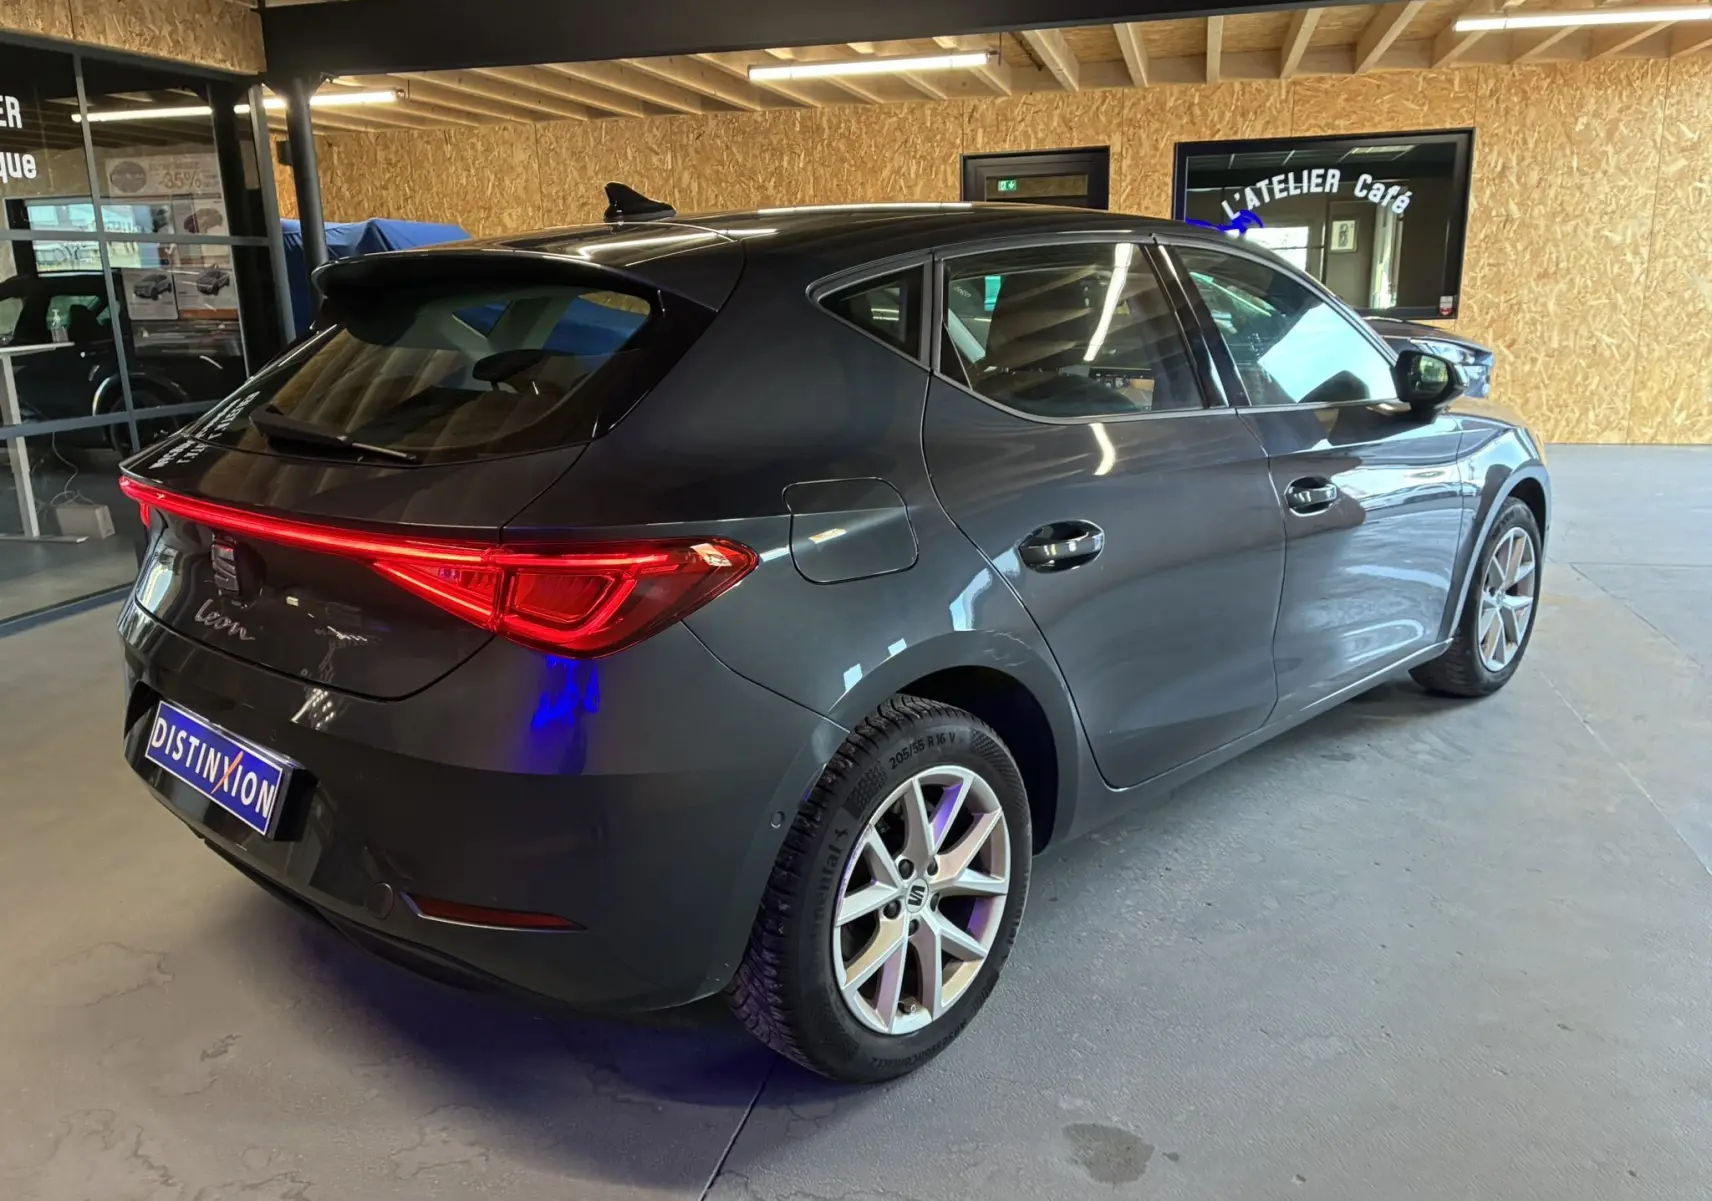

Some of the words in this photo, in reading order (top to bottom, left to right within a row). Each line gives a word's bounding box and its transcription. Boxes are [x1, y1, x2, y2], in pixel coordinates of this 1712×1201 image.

[1221, 168, 1341, 220] L'ATELIER
[1354, 173, 1413, 214] Café
[195, 599, 255, 640] Leon
[151, 717, 275, 818] DISTINXION
[889, 740, 925, 770] 205/55
[927, 735, 934, 748] R
[936, 732, 946, 746] 16
[948, 731, 956, 743] V
